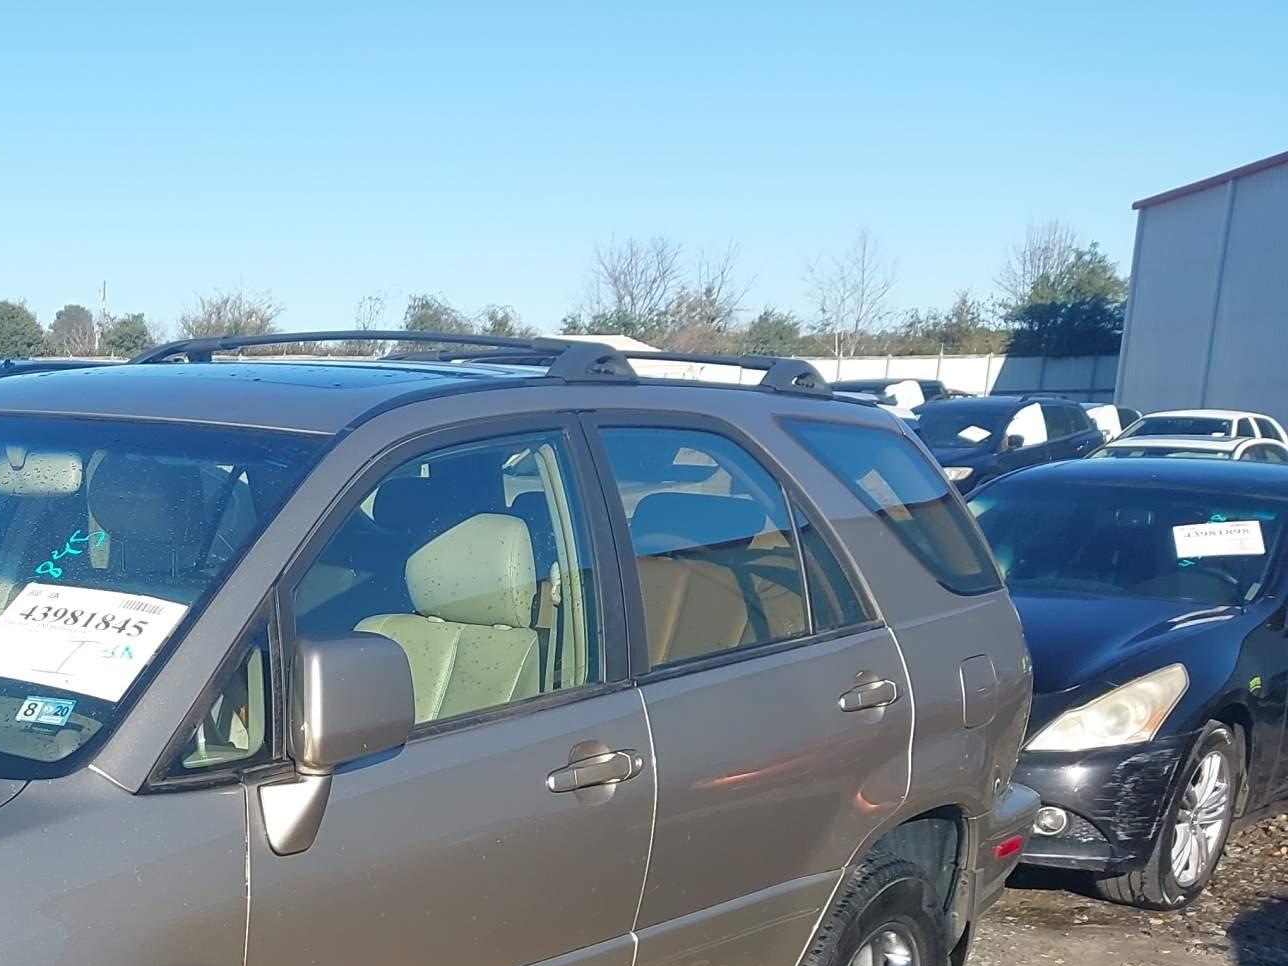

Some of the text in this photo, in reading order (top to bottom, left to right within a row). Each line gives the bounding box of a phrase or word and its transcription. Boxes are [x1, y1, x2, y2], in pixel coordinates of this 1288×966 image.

[19, 604, 149, 637] 43981845
[23, 702, 70, 717] 8 20
